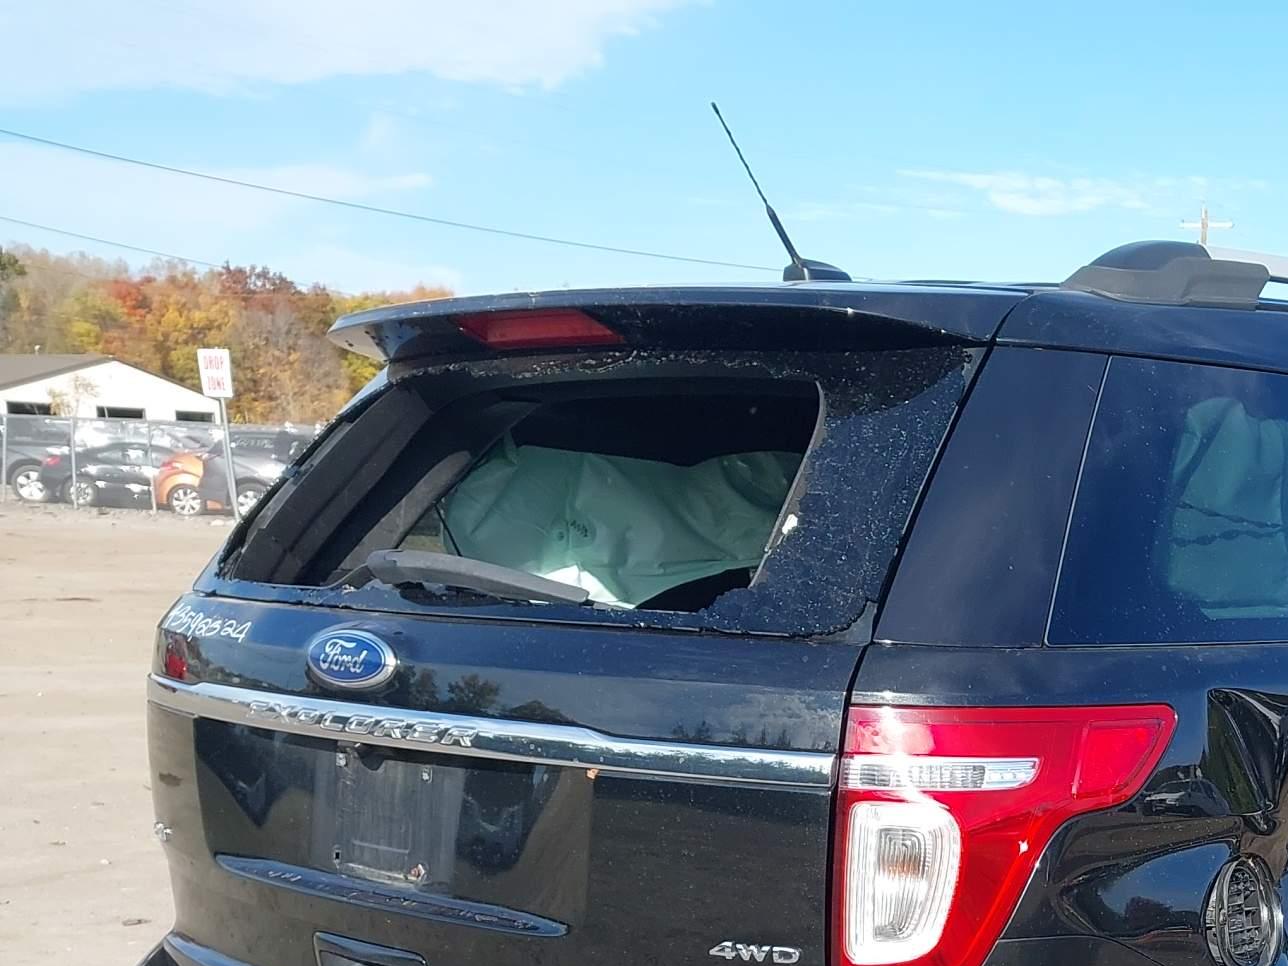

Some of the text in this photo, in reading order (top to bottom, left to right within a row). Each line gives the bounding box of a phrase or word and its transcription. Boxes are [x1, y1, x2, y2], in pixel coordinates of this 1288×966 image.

[203, 355, 225, 370] DROP
[206, 375, 226, 391] ZONE
[319, 639, 369, 673] Ford
[247, 700, 479, 748] EXPLORER
[708, 941, 802, 964] 4WD
